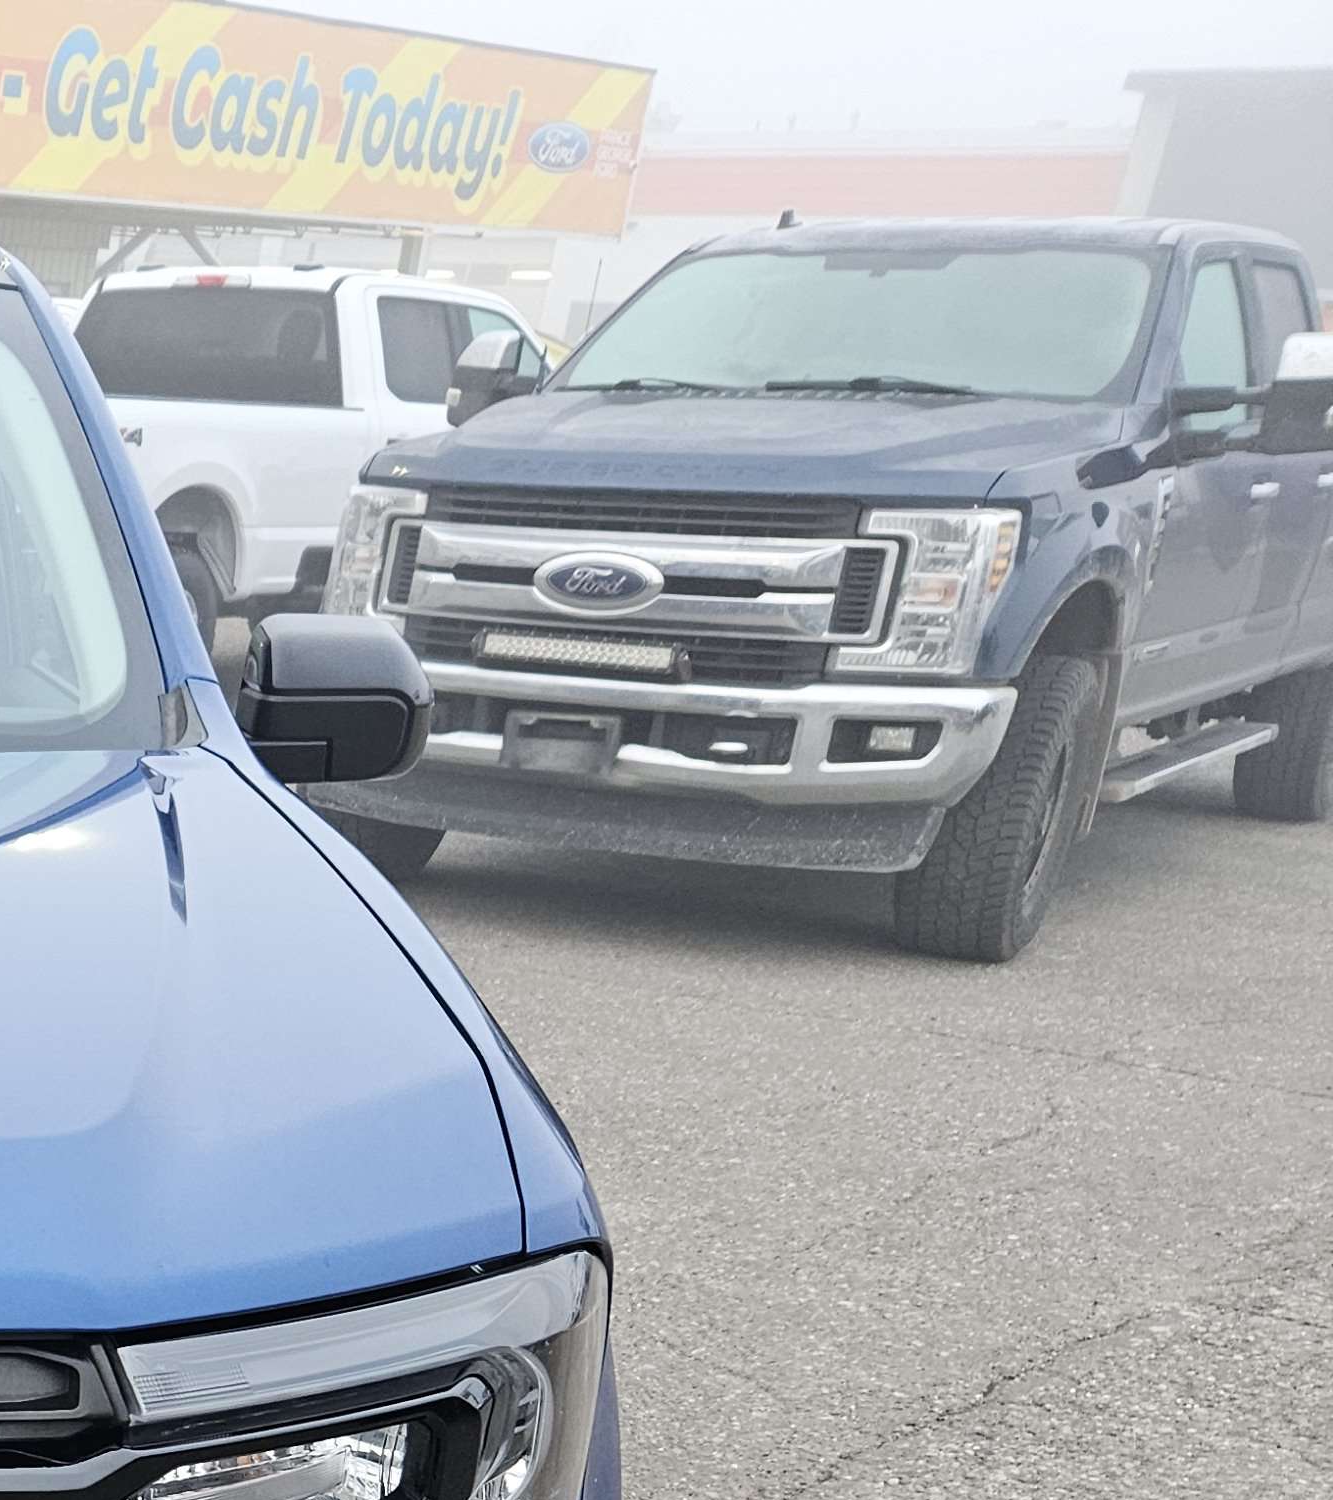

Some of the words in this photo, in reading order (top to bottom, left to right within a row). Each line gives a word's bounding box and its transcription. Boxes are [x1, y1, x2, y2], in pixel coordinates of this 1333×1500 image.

[2, 74, 24, 99] -
[45, 26, 160, 145] Get
[171, 43, 321, 161] Cash
[335, 66, 522, 201] Today!
[536, 127, 581, 165] Ford
[564, 566, 627, 595] Ford
